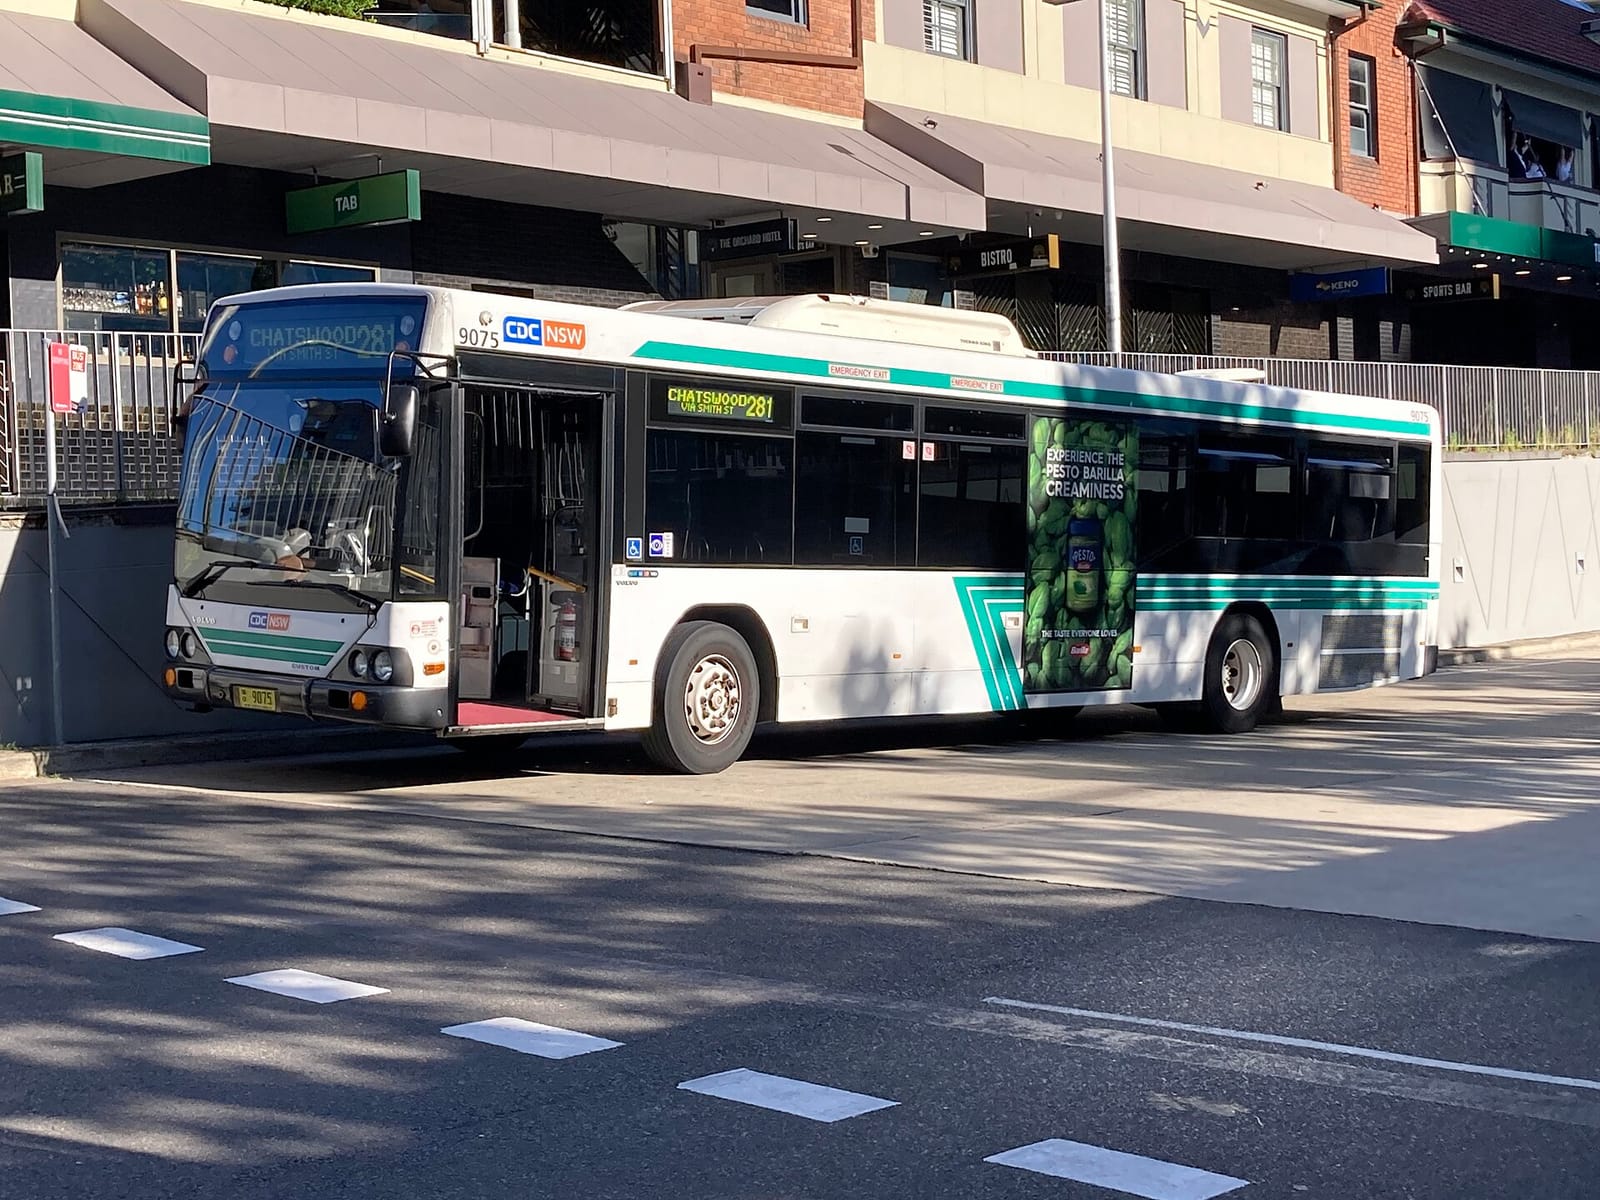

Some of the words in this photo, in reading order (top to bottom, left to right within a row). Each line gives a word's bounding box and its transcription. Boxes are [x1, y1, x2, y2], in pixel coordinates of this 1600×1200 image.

[335, 195, 358, 212] TAB
[762, 230, 782, 243] HOTEL
[981, 248, 1013, 268] BISTRO
[1331, 279, 1359, 290] KENO
[1423, 284, 1453, 298] SPORTS
[1455, 282, 1472, 295] BAR
[459, 327, 499, 348] 9075
[505, 320, 541, 341] CDC
[546, 325, 583, 345] NSW
[357, 324, 395, 359] 281
[830, 365, 871, 378] EMERGENCY
[873, 370, 888, 379] EXIT
[952, 378, 987, 390] EMERGENCY
[989, 383, 1002, 391] EXIT
[668, 388, 747, 407] CHATSWOOD
[746, 395, 773, 418] 281
[680, 402, 695, 412] VIA
[697, 403, 722, 414] SMITH
[723, 405, 734, 415] ST
[1046, 448, 1104, 464] EXPERIENCE
[1107, 453, 1124, 465] THE
[1046, 463, 1080, 479] PESTO
[1083, 466, 1124, 481] BARILLA
[1046, 480, 1124, 499] CREAMINESS
[250, 615, 267, 626] CDC
[269, 616, 289, 628] NSW
[1041, 630, 1053, 638] THE
[1054, 629, 1070, 637] TASTE
[1071, 629, 1100, 637] EVERYONE
[1100, 629, 1118, 637] LOVES
[251, 690, 272, 705] 9075
